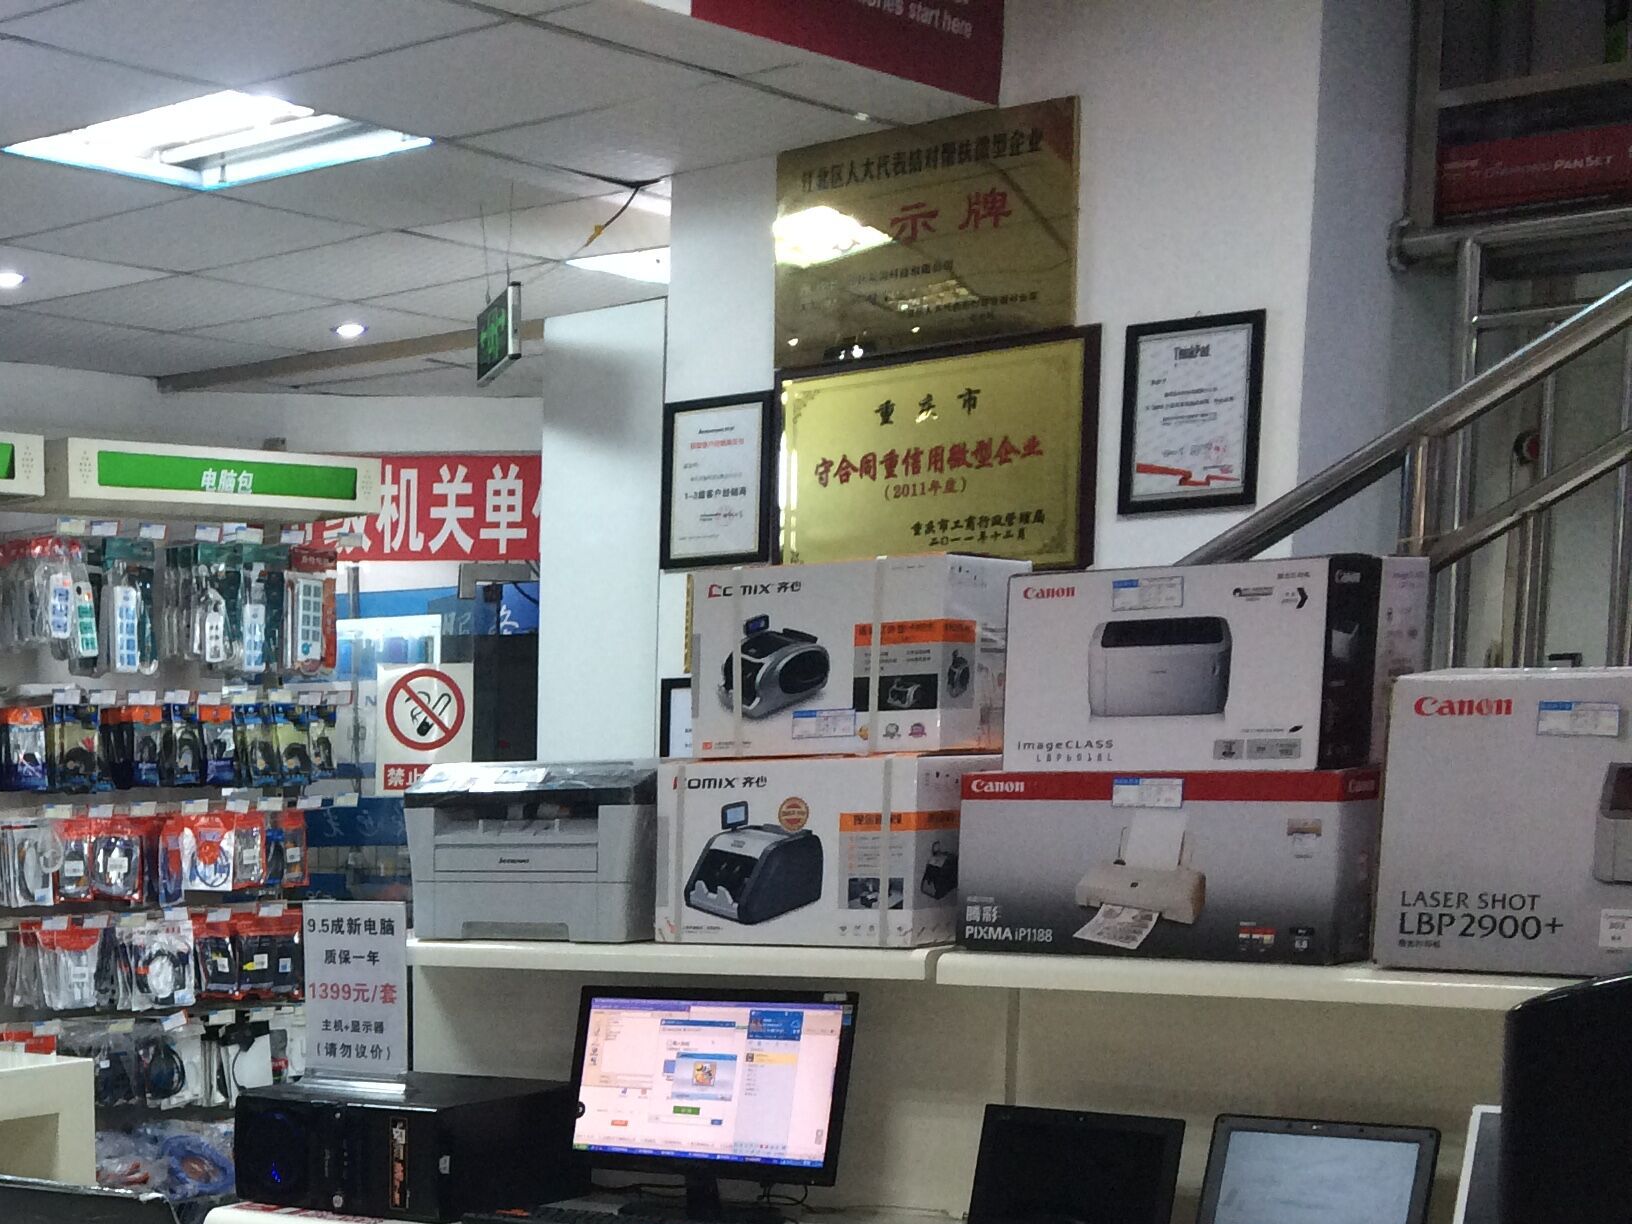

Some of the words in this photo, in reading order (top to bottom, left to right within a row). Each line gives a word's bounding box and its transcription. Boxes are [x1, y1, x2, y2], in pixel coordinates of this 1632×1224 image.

[908, 2, 941, 28] start
[942, 11, 972, 39] here
[814, 434, 1044, 488] 守合同重信用微型企业
[200, 467, 254, 495] 电脑包
[1023, 586, 1076, 600] Canon
[1414, 696, 1513, 717] Canon
[1018, 739, 1114, 752] imageCLASS
[672, 775, 736, 790] OMIX
[970, 778, 1025, 793] Canon
[1401, 890, 1469, 909] LASER
[1477, 893, 1541, 912] SHOT
[306, 916, 396, 937] 9.5成新电脑
[965, 925, 1013, 941] PIXMA
[1014, 927, 1053, 943] iP1188
[1398, 912, 1564, 941] LBP2900+
[323, 949, 380, 966] 质保一年
[308, 982, 398, 1005] 1399元/套
[321, 1019, 385, 1035] 主机+显示器
[317, 1041, 391, 1061] (请勿议价)
